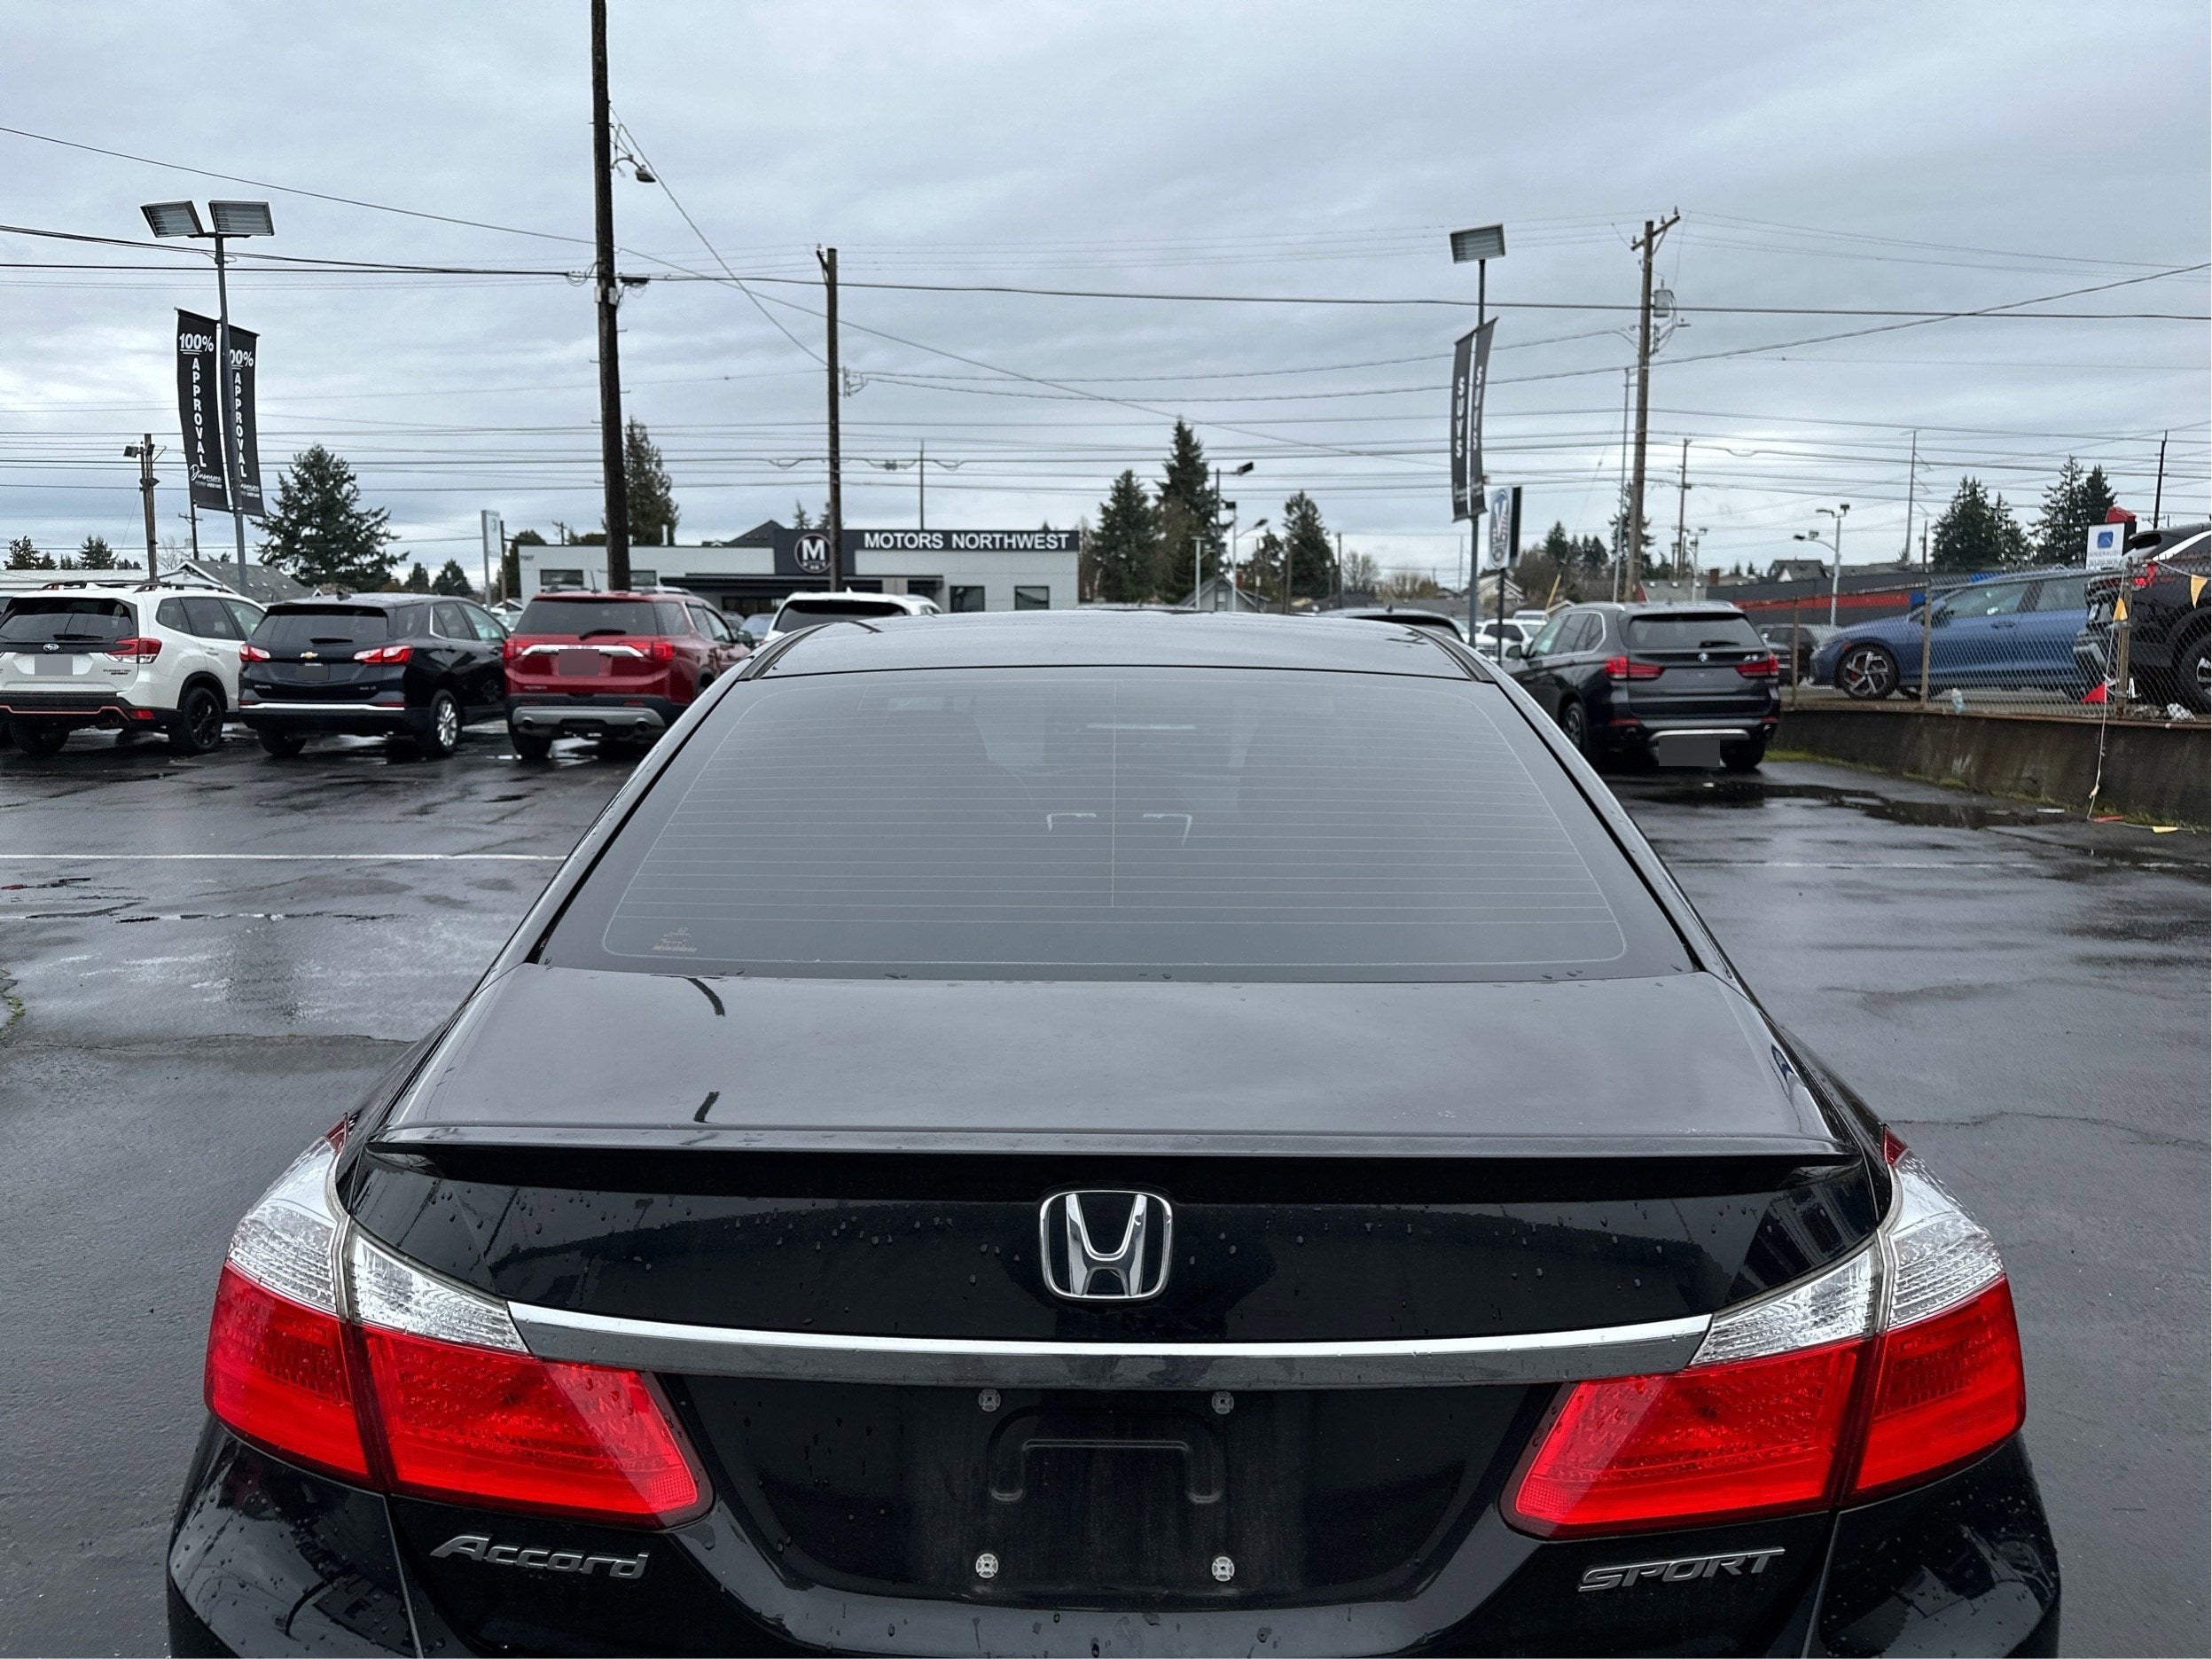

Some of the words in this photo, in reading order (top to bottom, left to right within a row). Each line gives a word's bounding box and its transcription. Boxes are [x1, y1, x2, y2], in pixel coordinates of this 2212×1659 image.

[179, 333, 215, 353] 100%
[230, 348, 254, 368] 00%
[191, 357, 207, 468] APPROVAL
[234, 372, 247, 478] APPROVAL
[1455, 375, 1465, 459] SUVS
[864, 532, 944, 549] MOTORS
[950, 532, 1070, 550] NORTHWEST
[429, 1532, 650, 1579] Accord
[1577, 1546, 1786, 1592] SPORT
